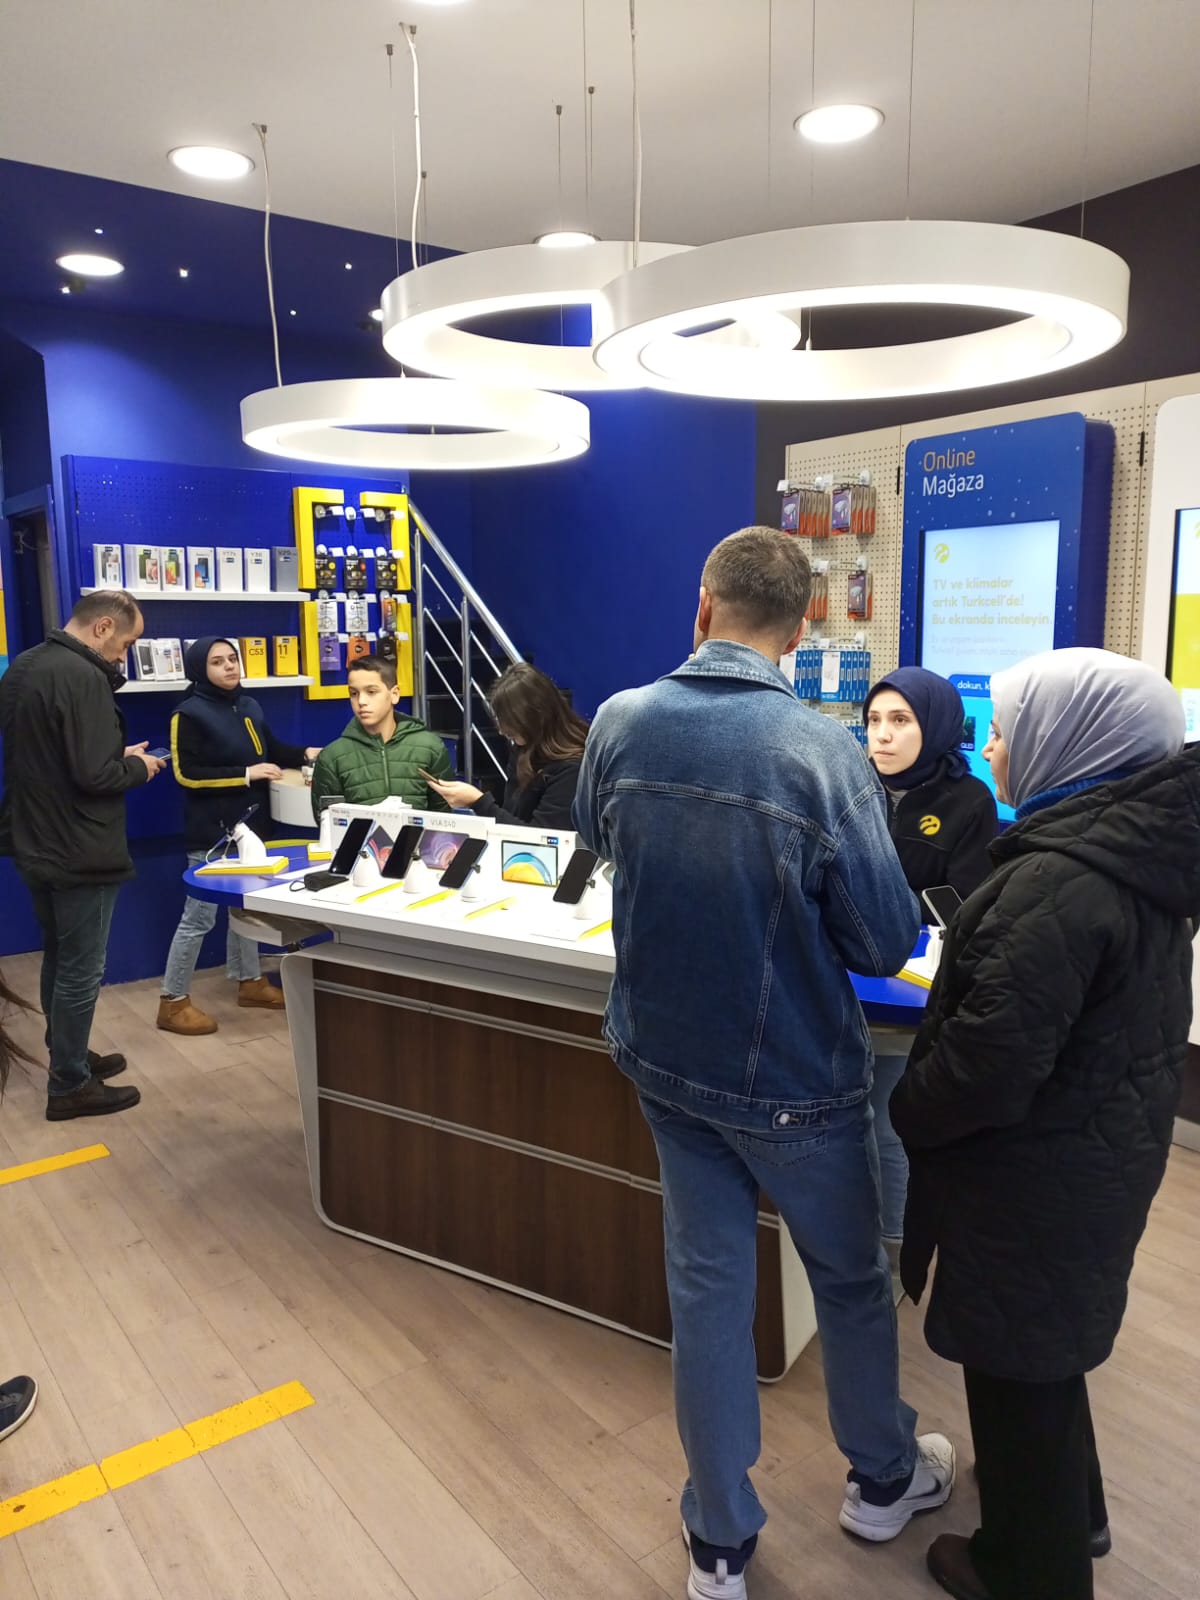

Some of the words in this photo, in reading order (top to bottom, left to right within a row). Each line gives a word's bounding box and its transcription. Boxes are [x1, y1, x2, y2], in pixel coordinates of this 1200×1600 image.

[922, 448, 976, 472] Online
[922, 473, 985, 498] Mağaza
[933, 579, 947, 590] TV
[950, 581, 963, 590] ve
[966, 576, 1014, 589] klimalar
[932, 613, 946, 625] Bu
[948, 612, 994, 625] ekranda
